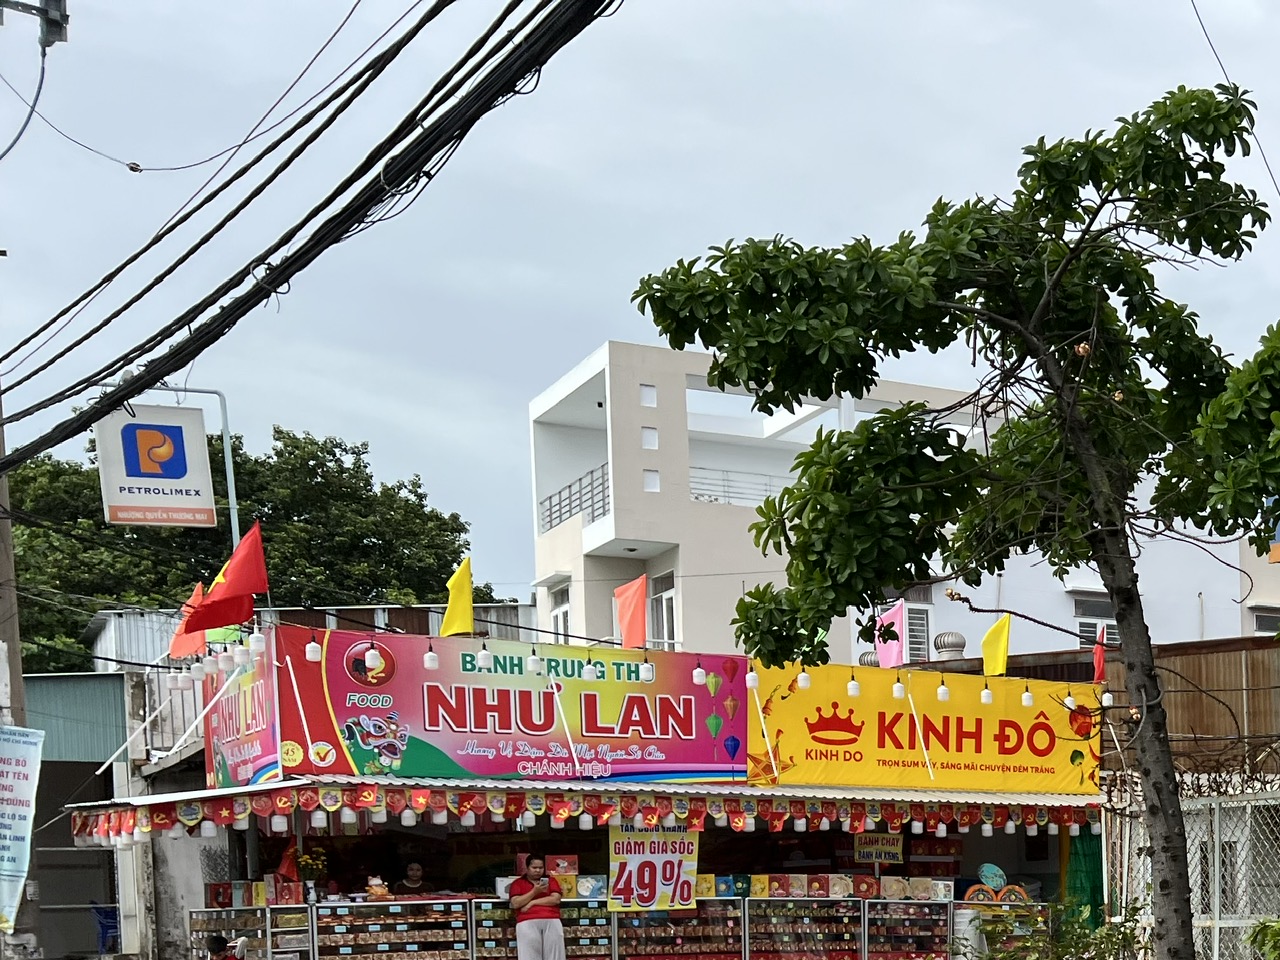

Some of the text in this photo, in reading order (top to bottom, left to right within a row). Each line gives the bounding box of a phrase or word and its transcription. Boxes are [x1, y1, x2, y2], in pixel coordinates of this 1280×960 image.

[119, 486, 201, 497] PETROLIMEX
[346, 693, 393, 708] FOOD
[423, 682, 696, 739] NHƯ LAN
[877, 710, 1056, 757] KINH ĐÔ
[805, 749, 864, 762] KINH DO
[876, 758, 900, 769] TRỌN
[901, 760, 919, 768] SUM
[518, 760, 612, 779] CHÁNH HIỆU
[614, 836, 645, 855] GIẢM
[670, 835, 694, 855] SỐC
[611, 859, 692, 908] 49%
